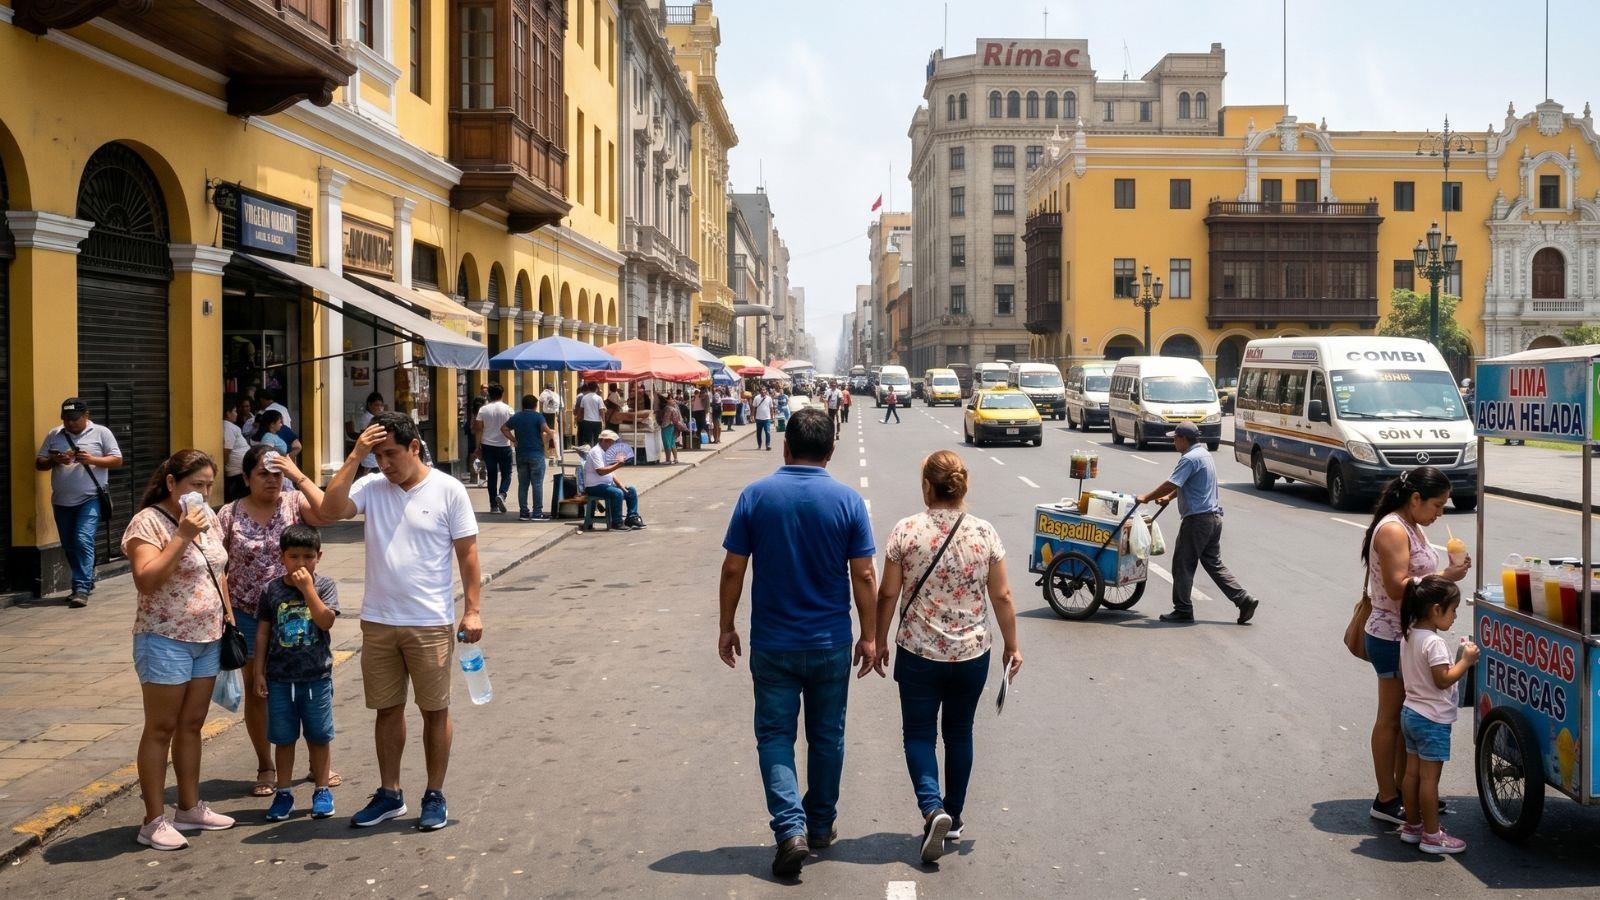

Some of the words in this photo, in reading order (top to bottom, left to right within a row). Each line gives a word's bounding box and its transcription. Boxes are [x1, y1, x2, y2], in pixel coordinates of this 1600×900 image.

[984, 42, 1080, 67] Rímac
[1346, 351, 1426, 363] COMBI
[1509, 367, 1547, 397] LIMA
[1477, 401, 1516, 431] AGUA
[1519, 403, 1583, 435] HELADA
[1429, 429, 1451, 439] 16
[1039, 513, 1111, 544] Raspadillas
[1480, 615, 1576, 683] GASEOSAS
[1486, 655, 1567, 722] FRESCAS
